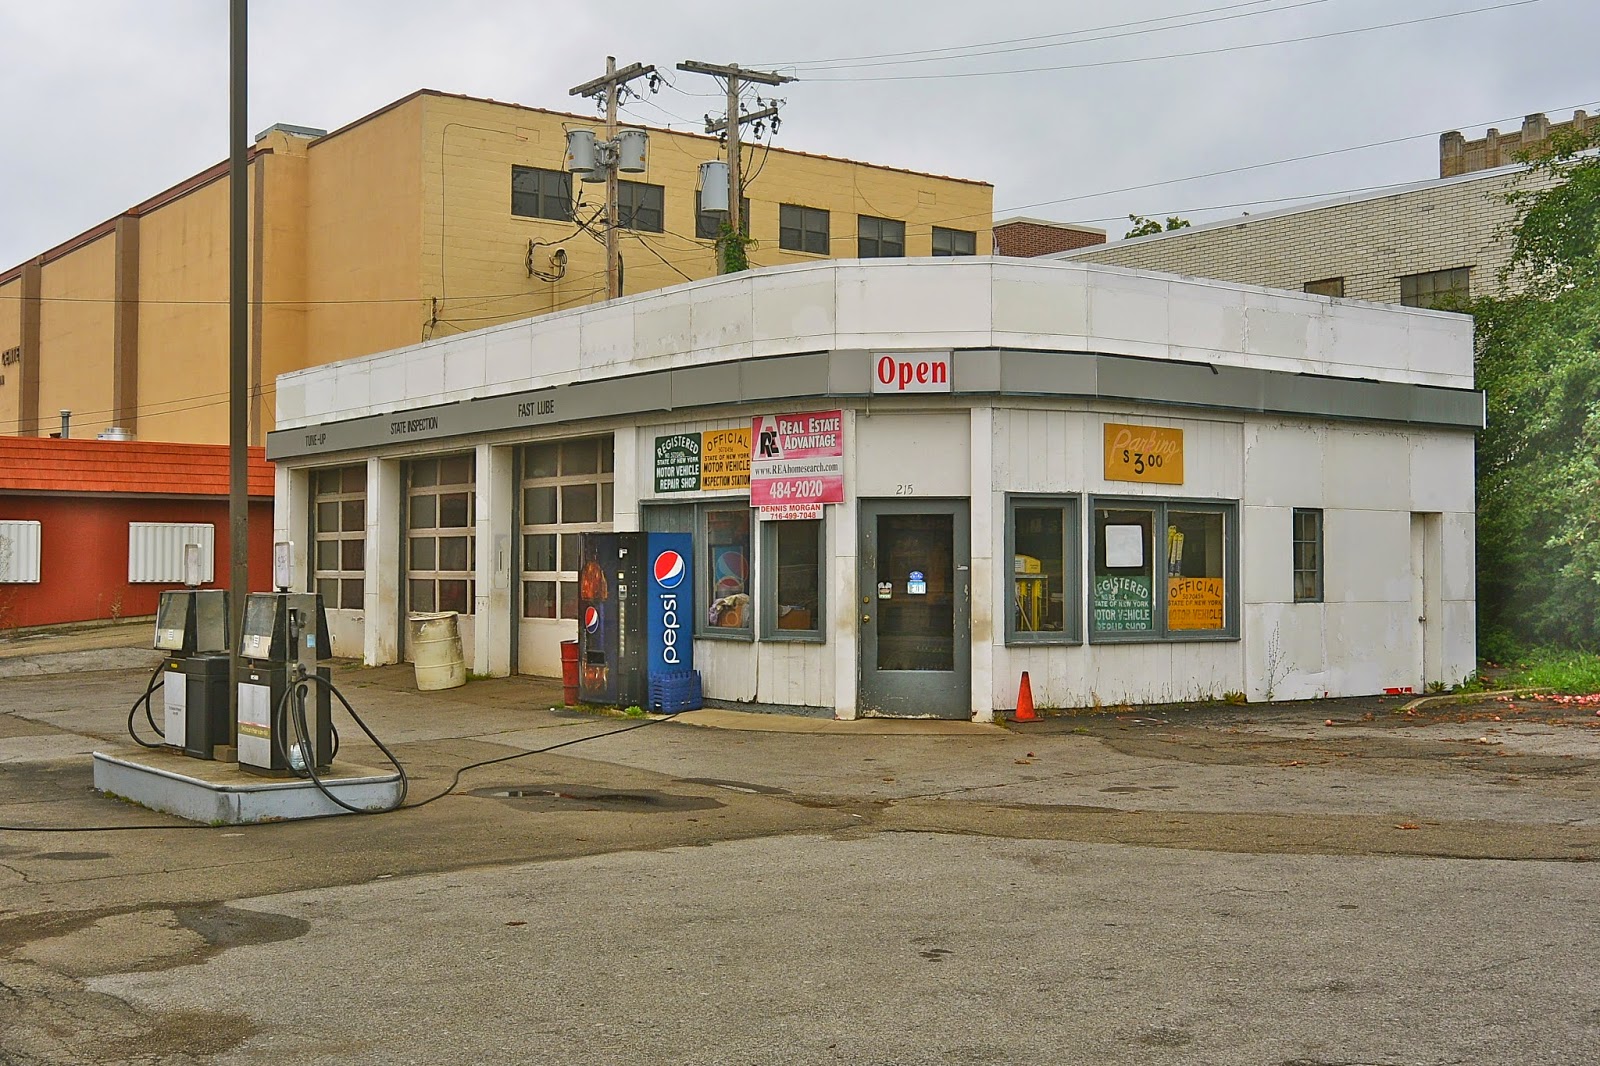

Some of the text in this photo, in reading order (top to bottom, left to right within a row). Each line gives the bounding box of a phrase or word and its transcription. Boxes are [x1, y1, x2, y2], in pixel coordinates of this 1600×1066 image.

[877, 355, 947, 390] Open
[518, 400, 554, 418] FAST LUBE
[390, 416, 438, 435] STATE INSPECTION
[779, 417, 840, 435] REAL ESTATE
[305, 433, 326, 447] TUNE-UP
[656, 436, 699, 459] REGISTERED
[707, 432, 749, 451] OFFICIAL
[784, 433, 836, 450] ADVANTAGE
[1108, 428, 1180, 468] Parking
[657, 458, 670, 466] STATE
[702, 459, 750, 473] MOTOR VEHICLE
[755, 462, 838, 476] www.REAhomesearch.com
[656, 464, 700, 478] MOTOR VEHICLE
[660, 477, 697, 490] REPAIR SHOP
[701, 474, 750, 487] INSPECTION STATION
[769, 479, 823, 499] 484-2020
[896, 484, 914, 495] 215
[760, 503, 821, 513] DENNIS MORGAN
[770, 511, 817, 520] 716-499-7048
[1094, 577, 1148, 599] EGISTERED
[1170, 580, 1220, 598] OFFICIAL
[1117, 609, 1150, 621] VEHICLE
[660, 593, 680, 664] pepsi
